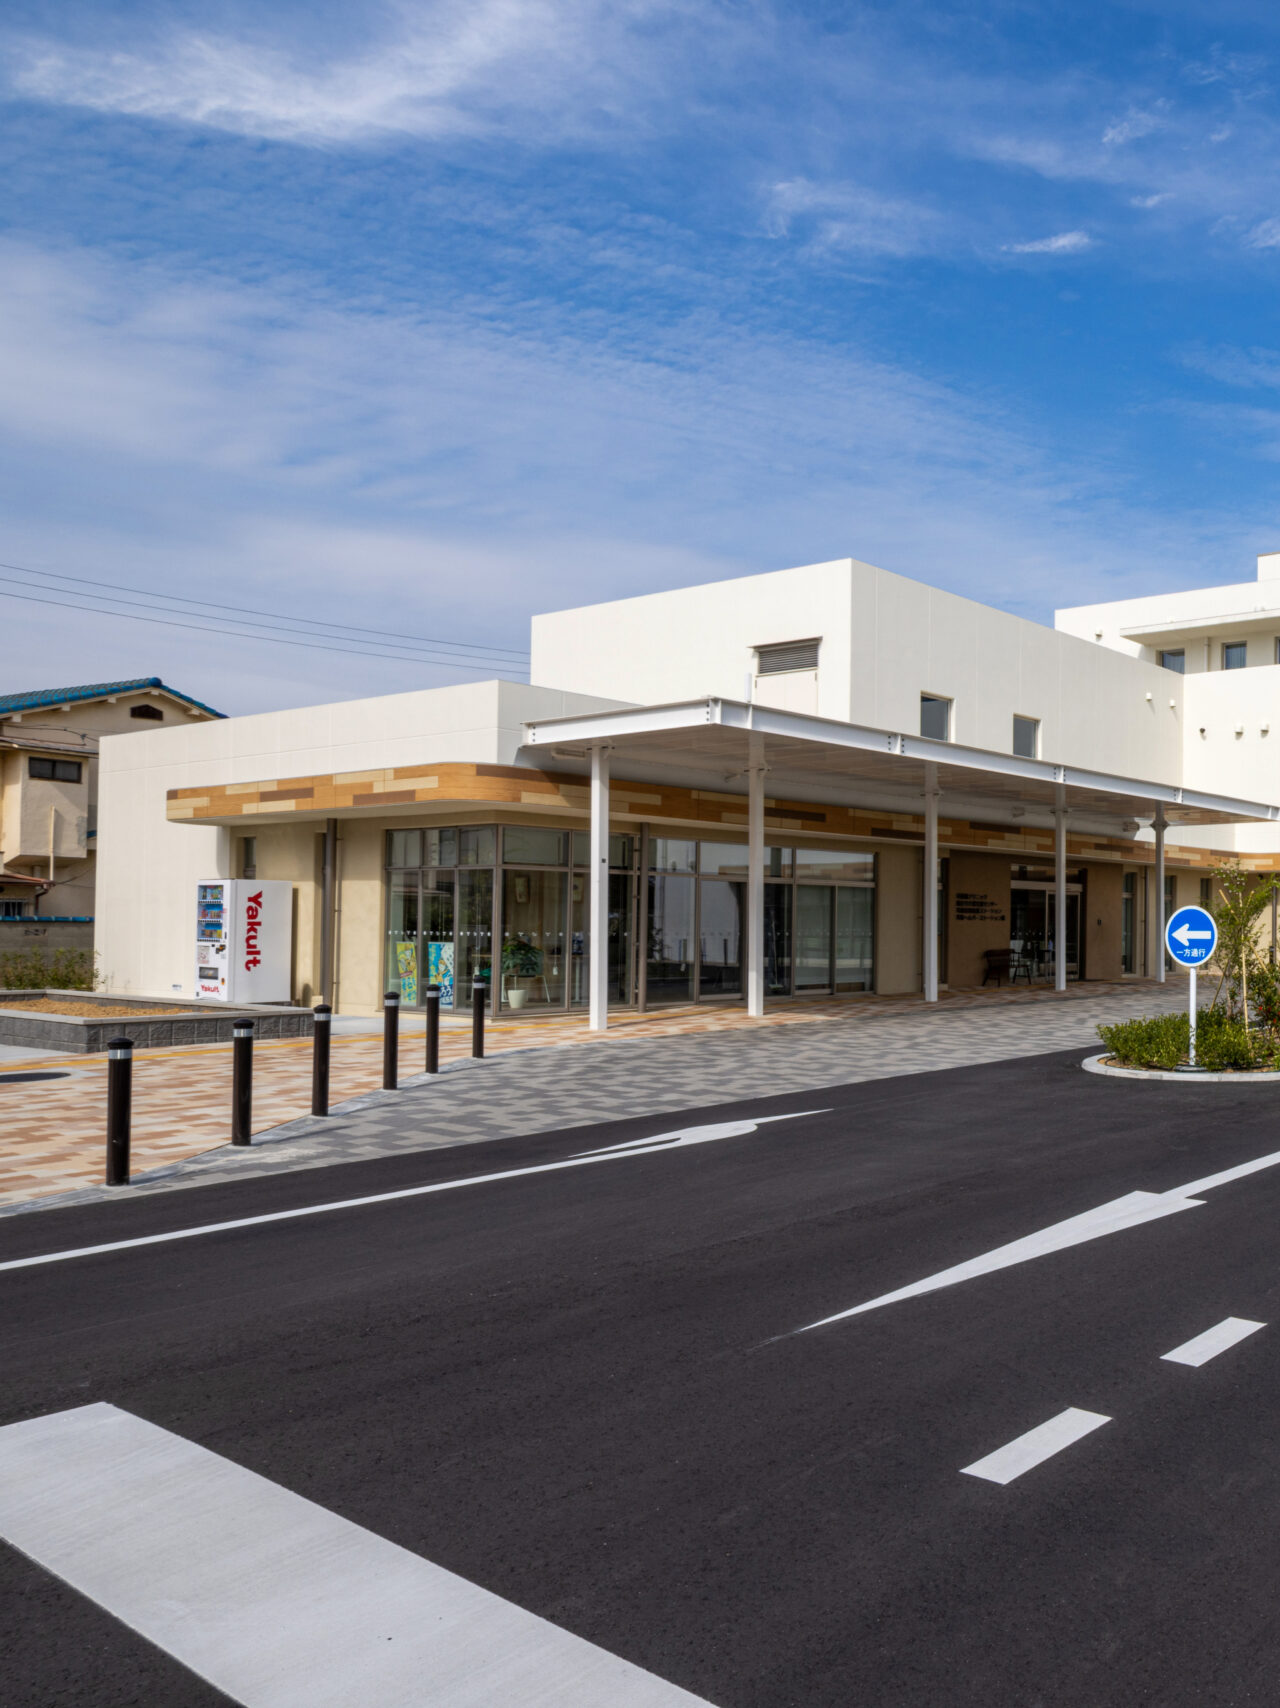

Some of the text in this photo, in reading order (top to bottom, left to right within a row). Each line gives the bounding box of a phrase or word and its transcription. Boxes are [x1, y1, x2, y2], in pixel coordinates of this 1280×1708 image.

[245, 890, 263, 972] Yakult
[1176, 948, 1206, 958] 一方通行
[200, 984, 220, 993] Yakult
